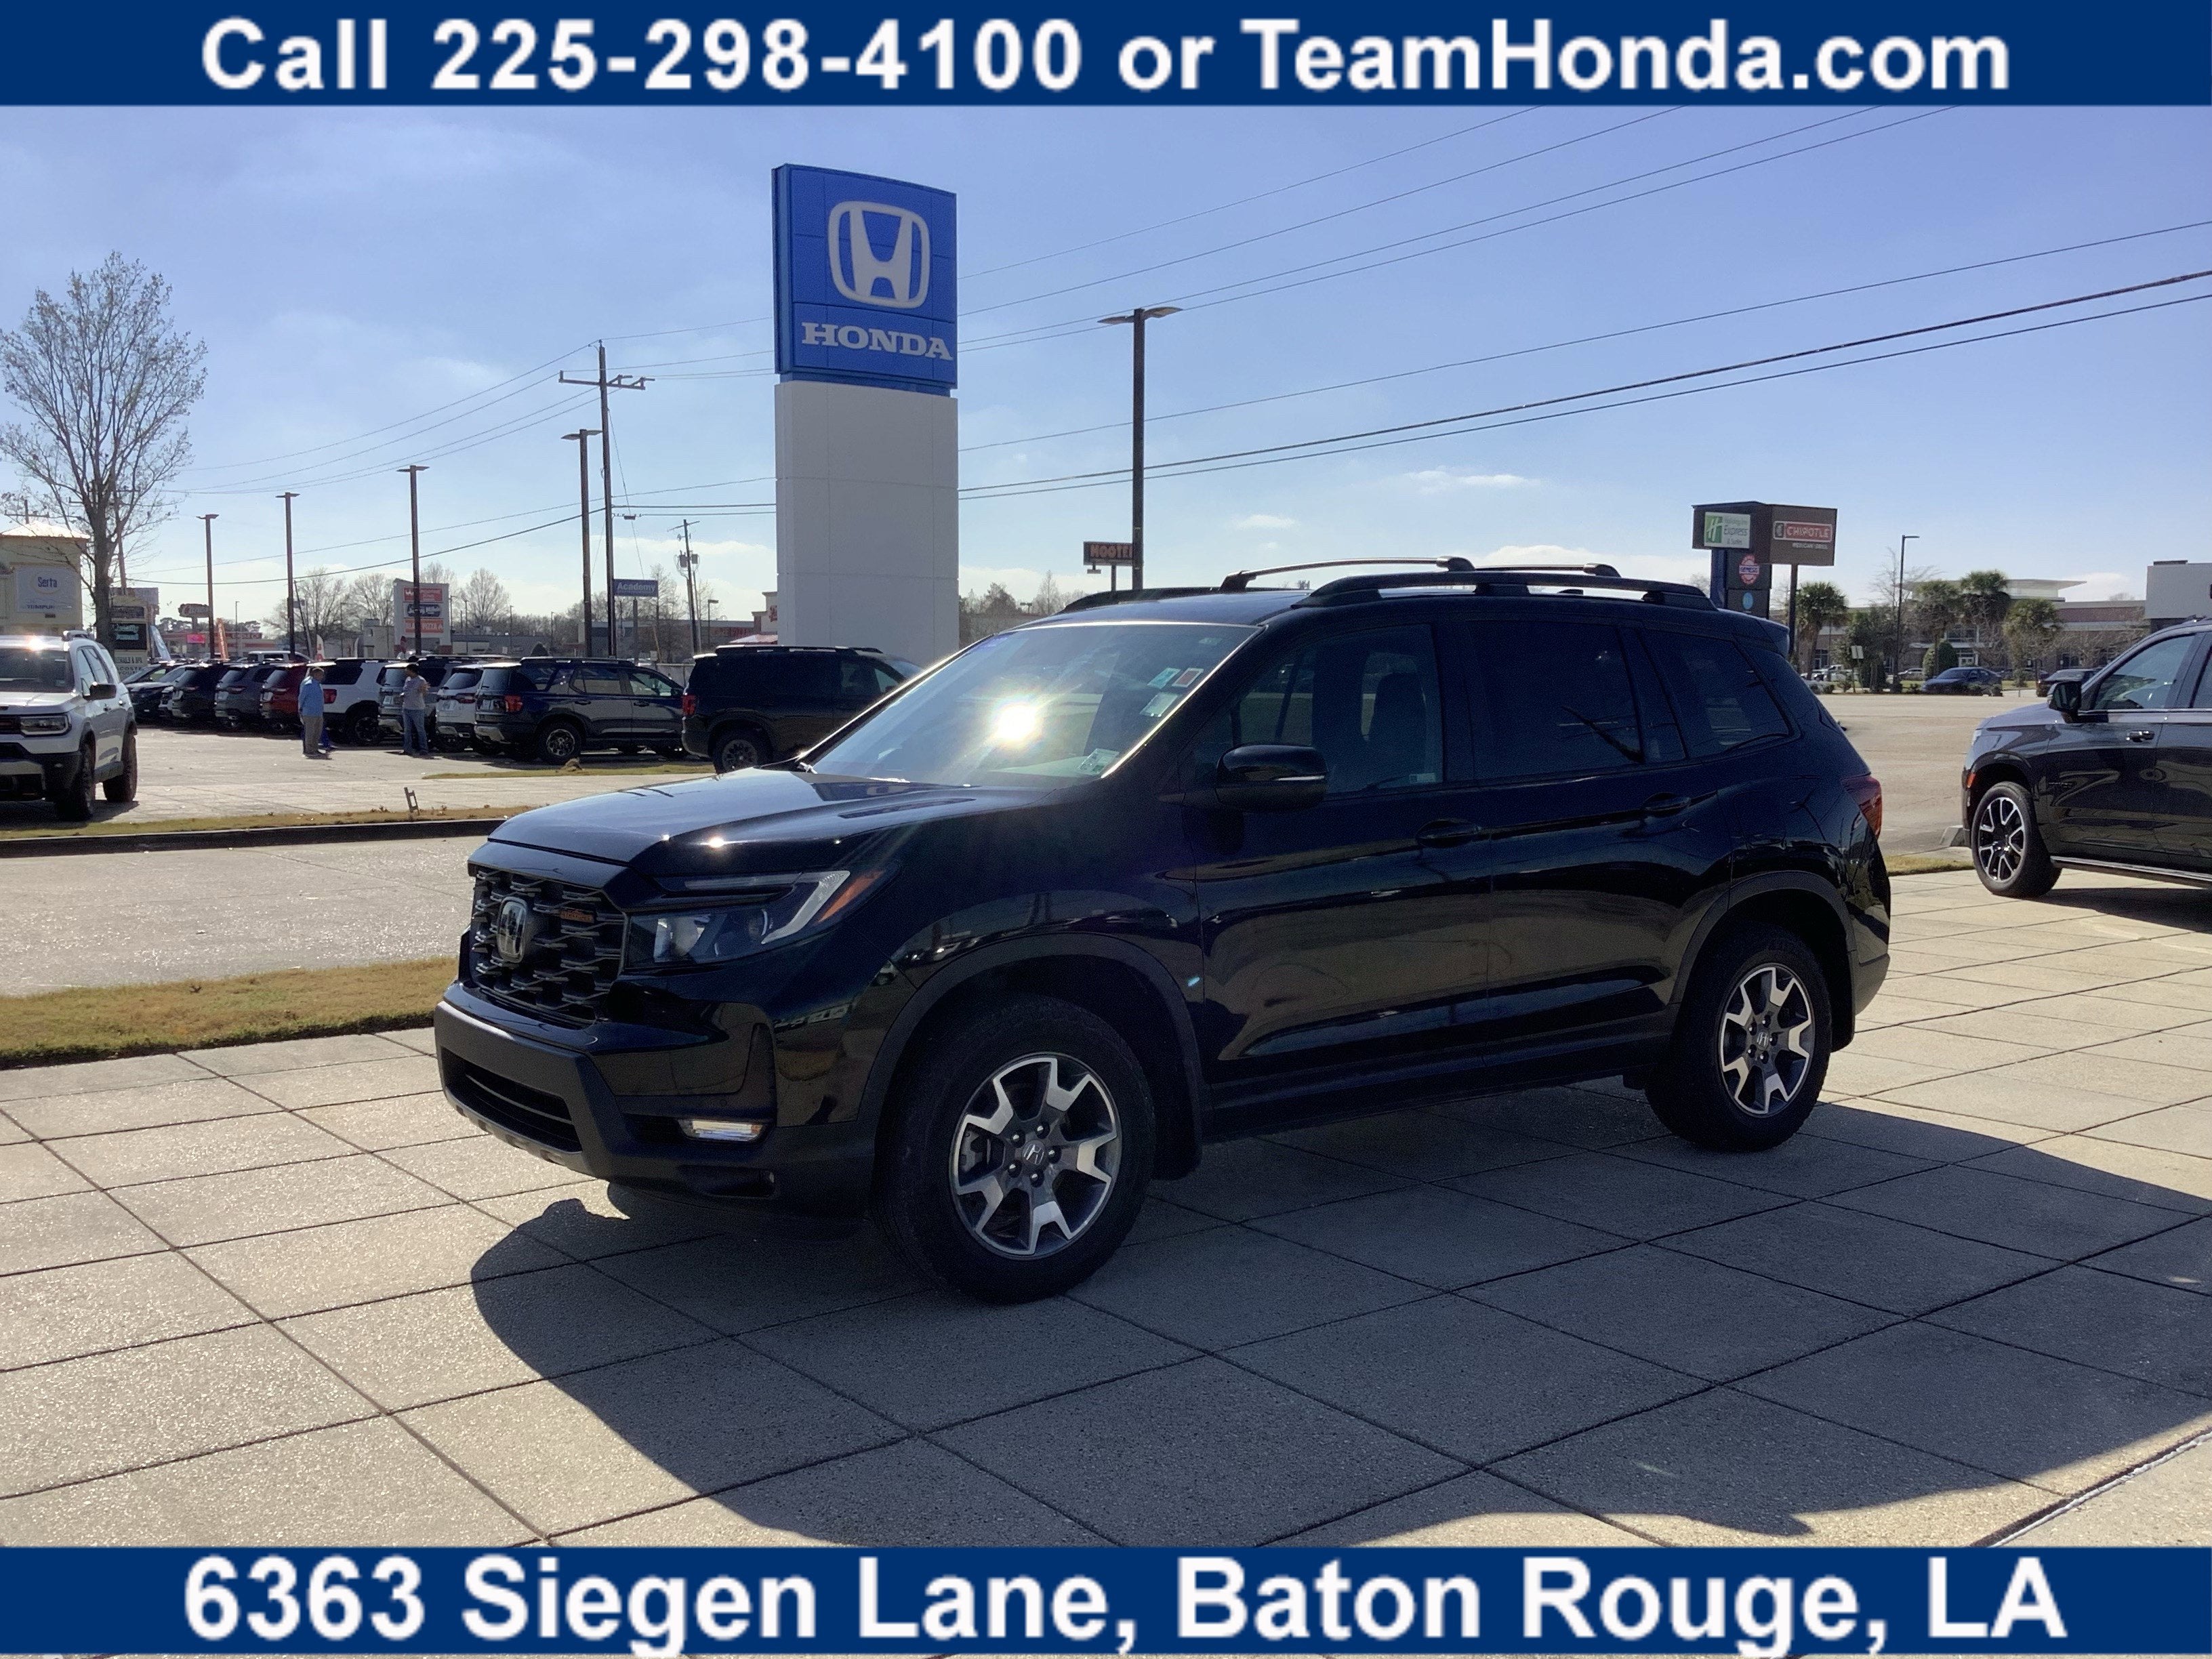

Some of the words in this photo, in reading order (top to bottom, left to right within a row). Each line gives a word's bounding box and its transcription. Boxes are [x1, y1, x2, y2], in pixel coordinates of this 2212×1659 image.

[801, 322, 954, 361] HONDA
[1786, 527, 1829, 538] CHIPOTLE
[37, 576, 58, 588] Serta
[617, 582, 655, 592] Academy
